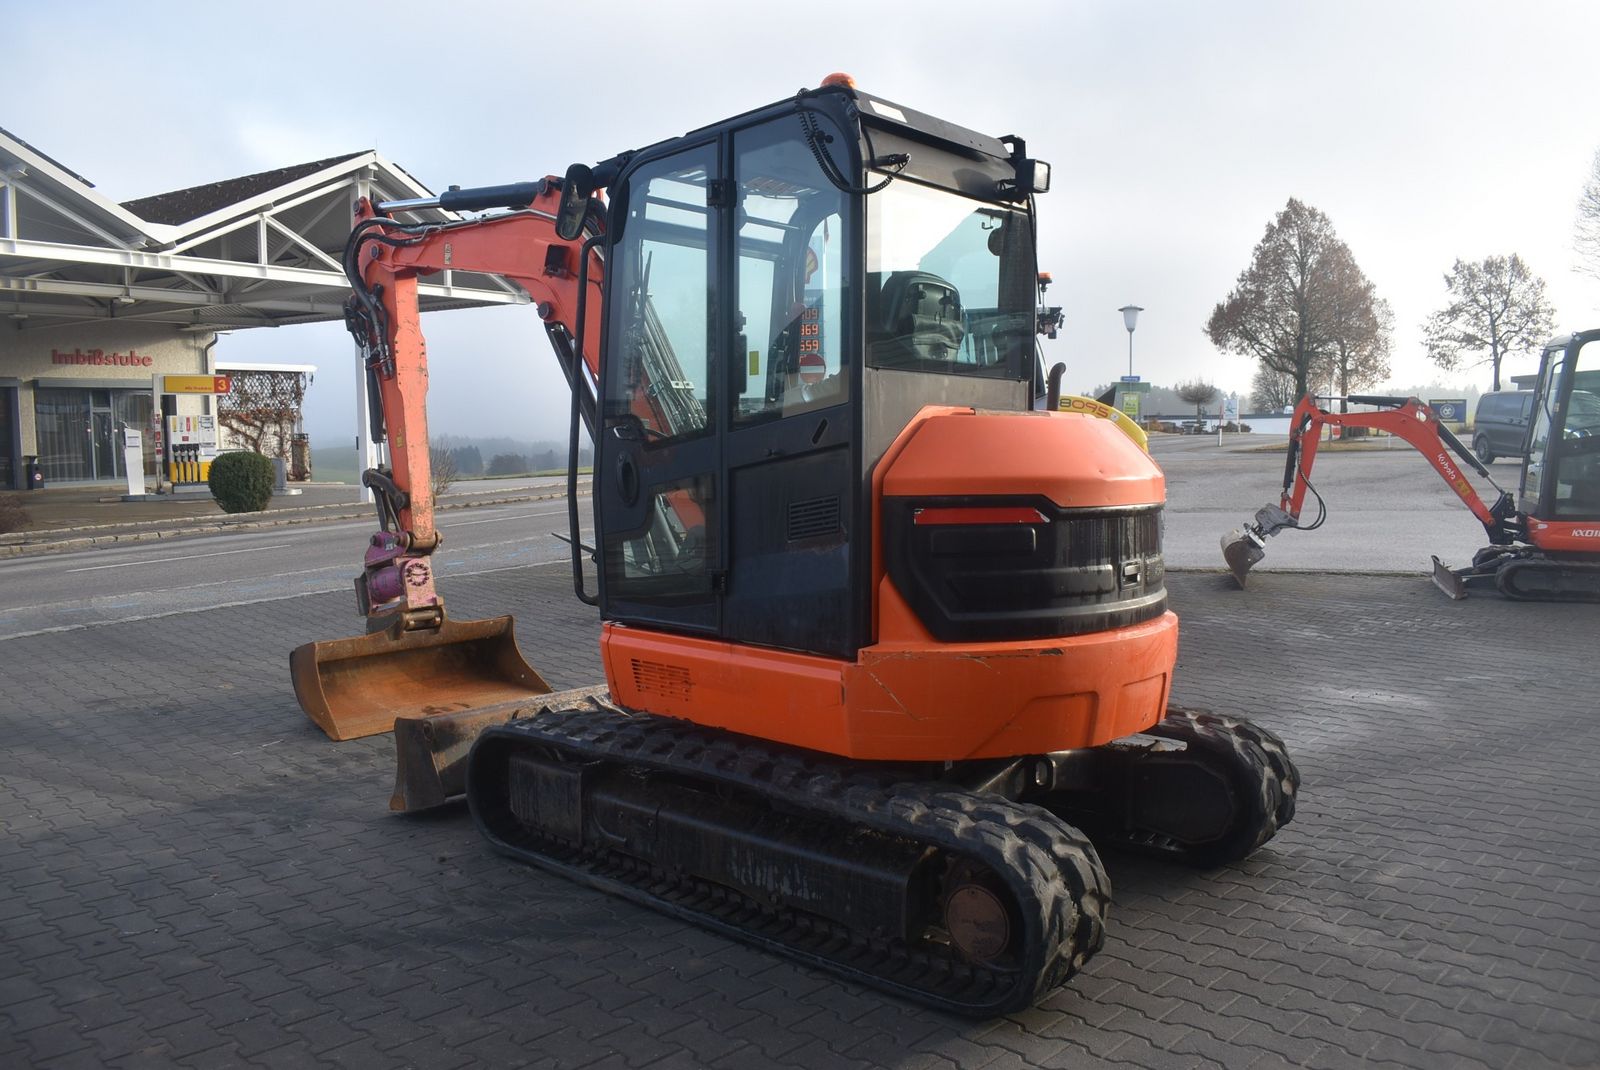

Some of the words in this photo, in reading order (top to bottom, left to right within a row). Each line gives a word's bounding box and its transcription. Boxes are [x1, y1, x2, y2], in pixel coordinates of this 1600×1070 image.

[52, 348, 153, 366] Imbißstube
[218, 379, 227, 391] 3
[1060, 398, 1109, 418] 8095
[1437, 453, 1456, 480] Kubota
